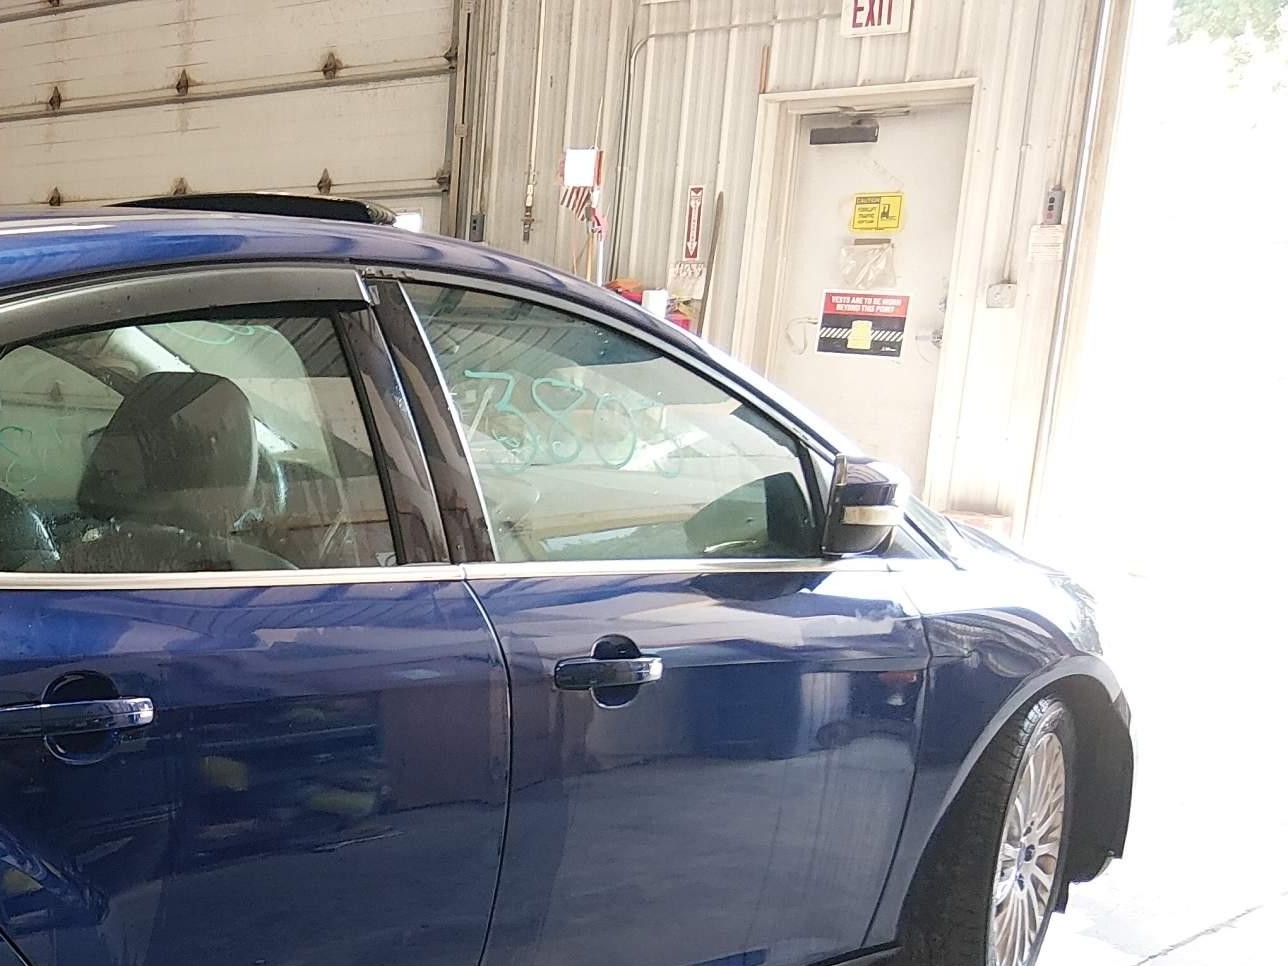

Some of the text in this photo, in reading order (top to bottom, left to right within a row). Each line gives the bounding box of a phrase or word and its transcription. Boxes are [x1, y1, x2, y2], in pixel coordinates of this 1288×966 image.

[852, 0, 893, 28] EXIT
[831, 296, 851, 304] VESTS
[851, 297, 863, 305] ARE
